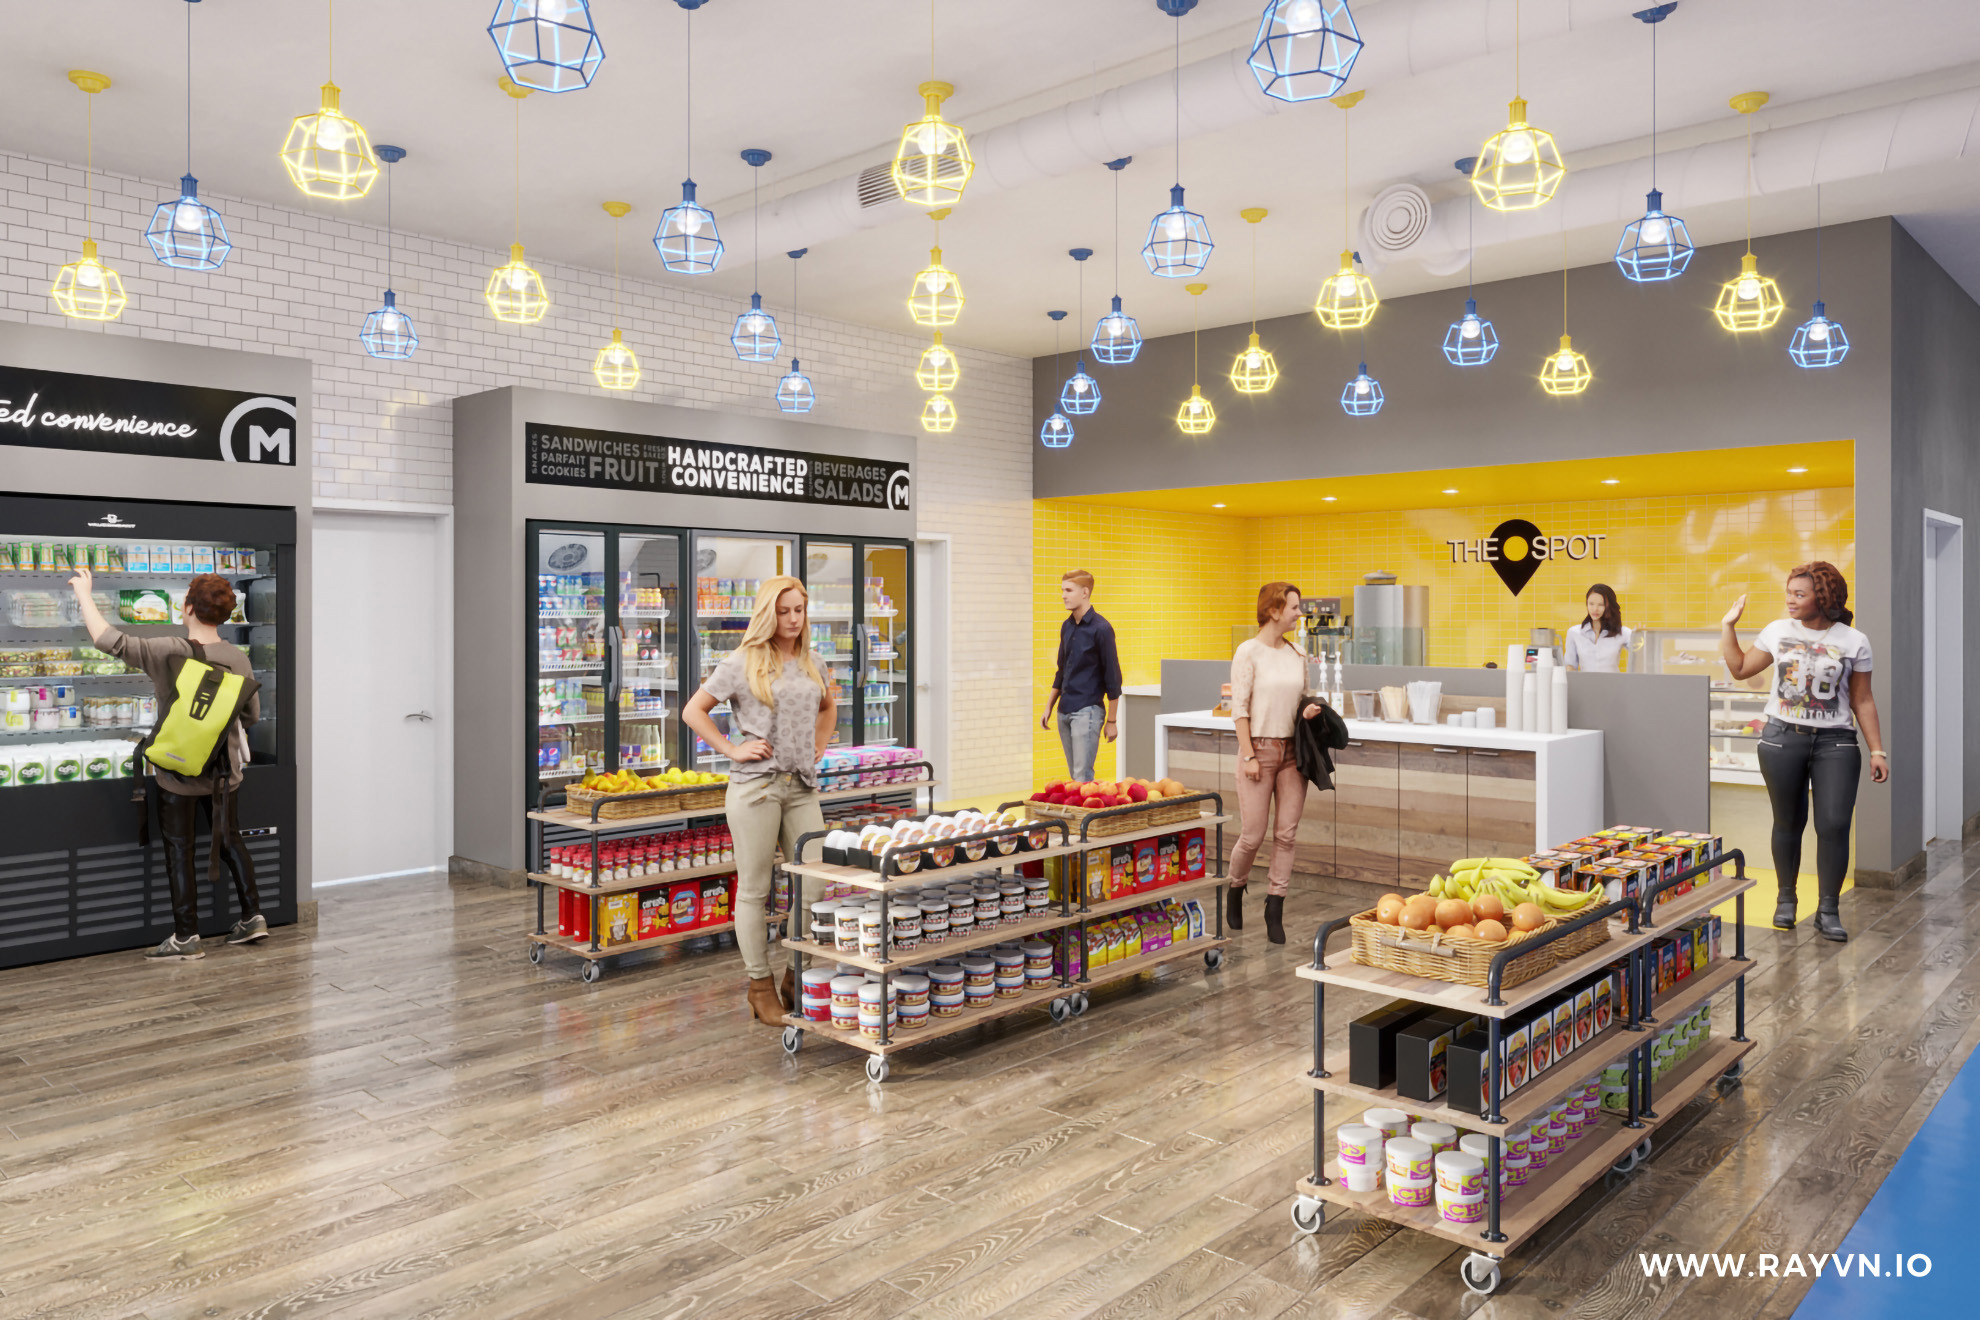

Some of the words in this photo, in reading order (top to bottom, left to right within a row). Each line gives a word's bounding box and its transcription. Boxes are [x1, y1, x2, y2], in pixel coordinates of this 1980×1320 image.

[41, 411, 198, 438] convenience
[541, 434, 640, 458] SANDWICHES
[541, 452, 586, 466] PARFAIT
[541, 465, 586, 478] COOKIES
[589, 455, 659, 484] FRUIT
[667, 445, 808, 477] HANDCRAFTED
[814, 461, 887, 482] BEVERAGES
[671, 466, 804, 496] CONVENIENCE
[814, 478, 884, 504] SALADS
[1447, 537, 1499, 563] THE
[1531, 533, 1607, 561] SPOT
[1777, 704, 1839, 719] OWNTOW
